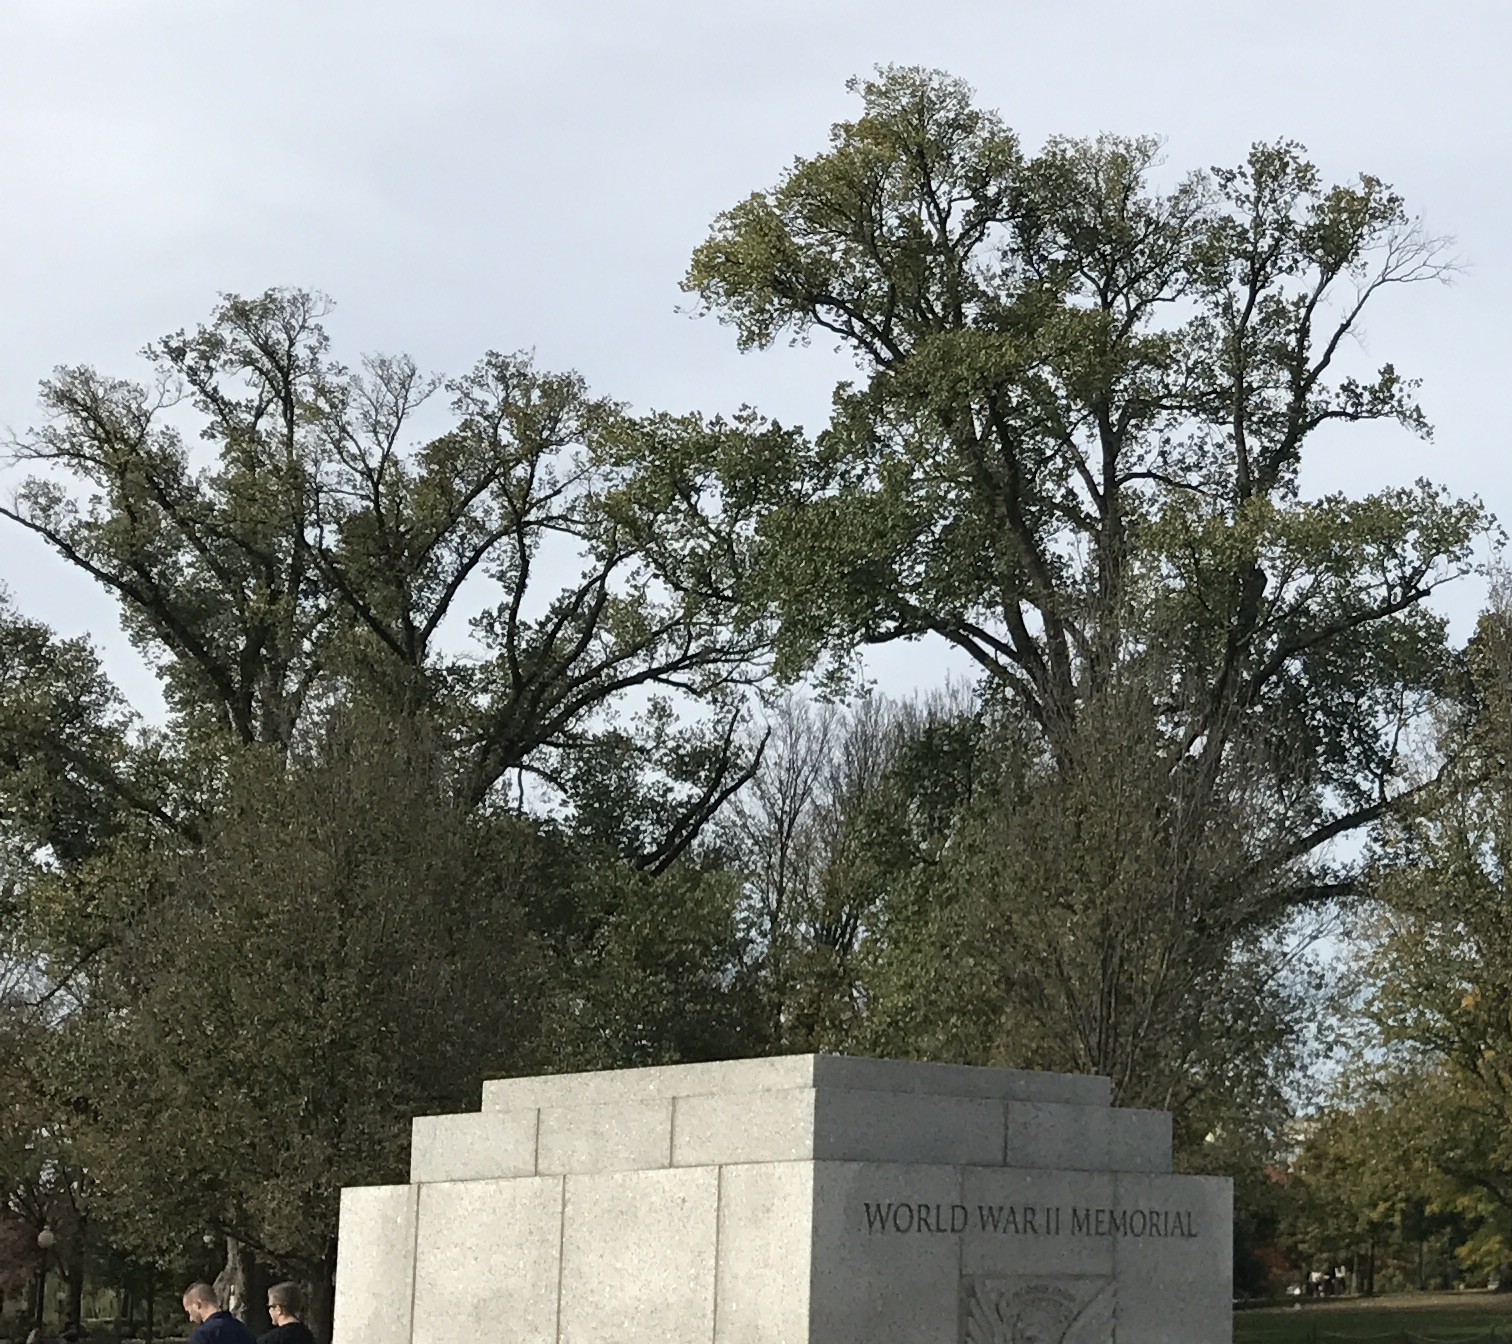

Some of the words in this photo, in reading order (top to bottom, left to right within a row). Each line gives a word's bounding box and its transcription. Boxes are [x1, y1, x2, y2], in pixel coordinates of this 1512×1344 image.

[864, 1202, 968, 1234] WORLD
[977, 1204, 1039, 1235] WAR
[1046, 1206, 1060, 1236] II
[1070, 1207, 1198, 1238] MEMORIAL
